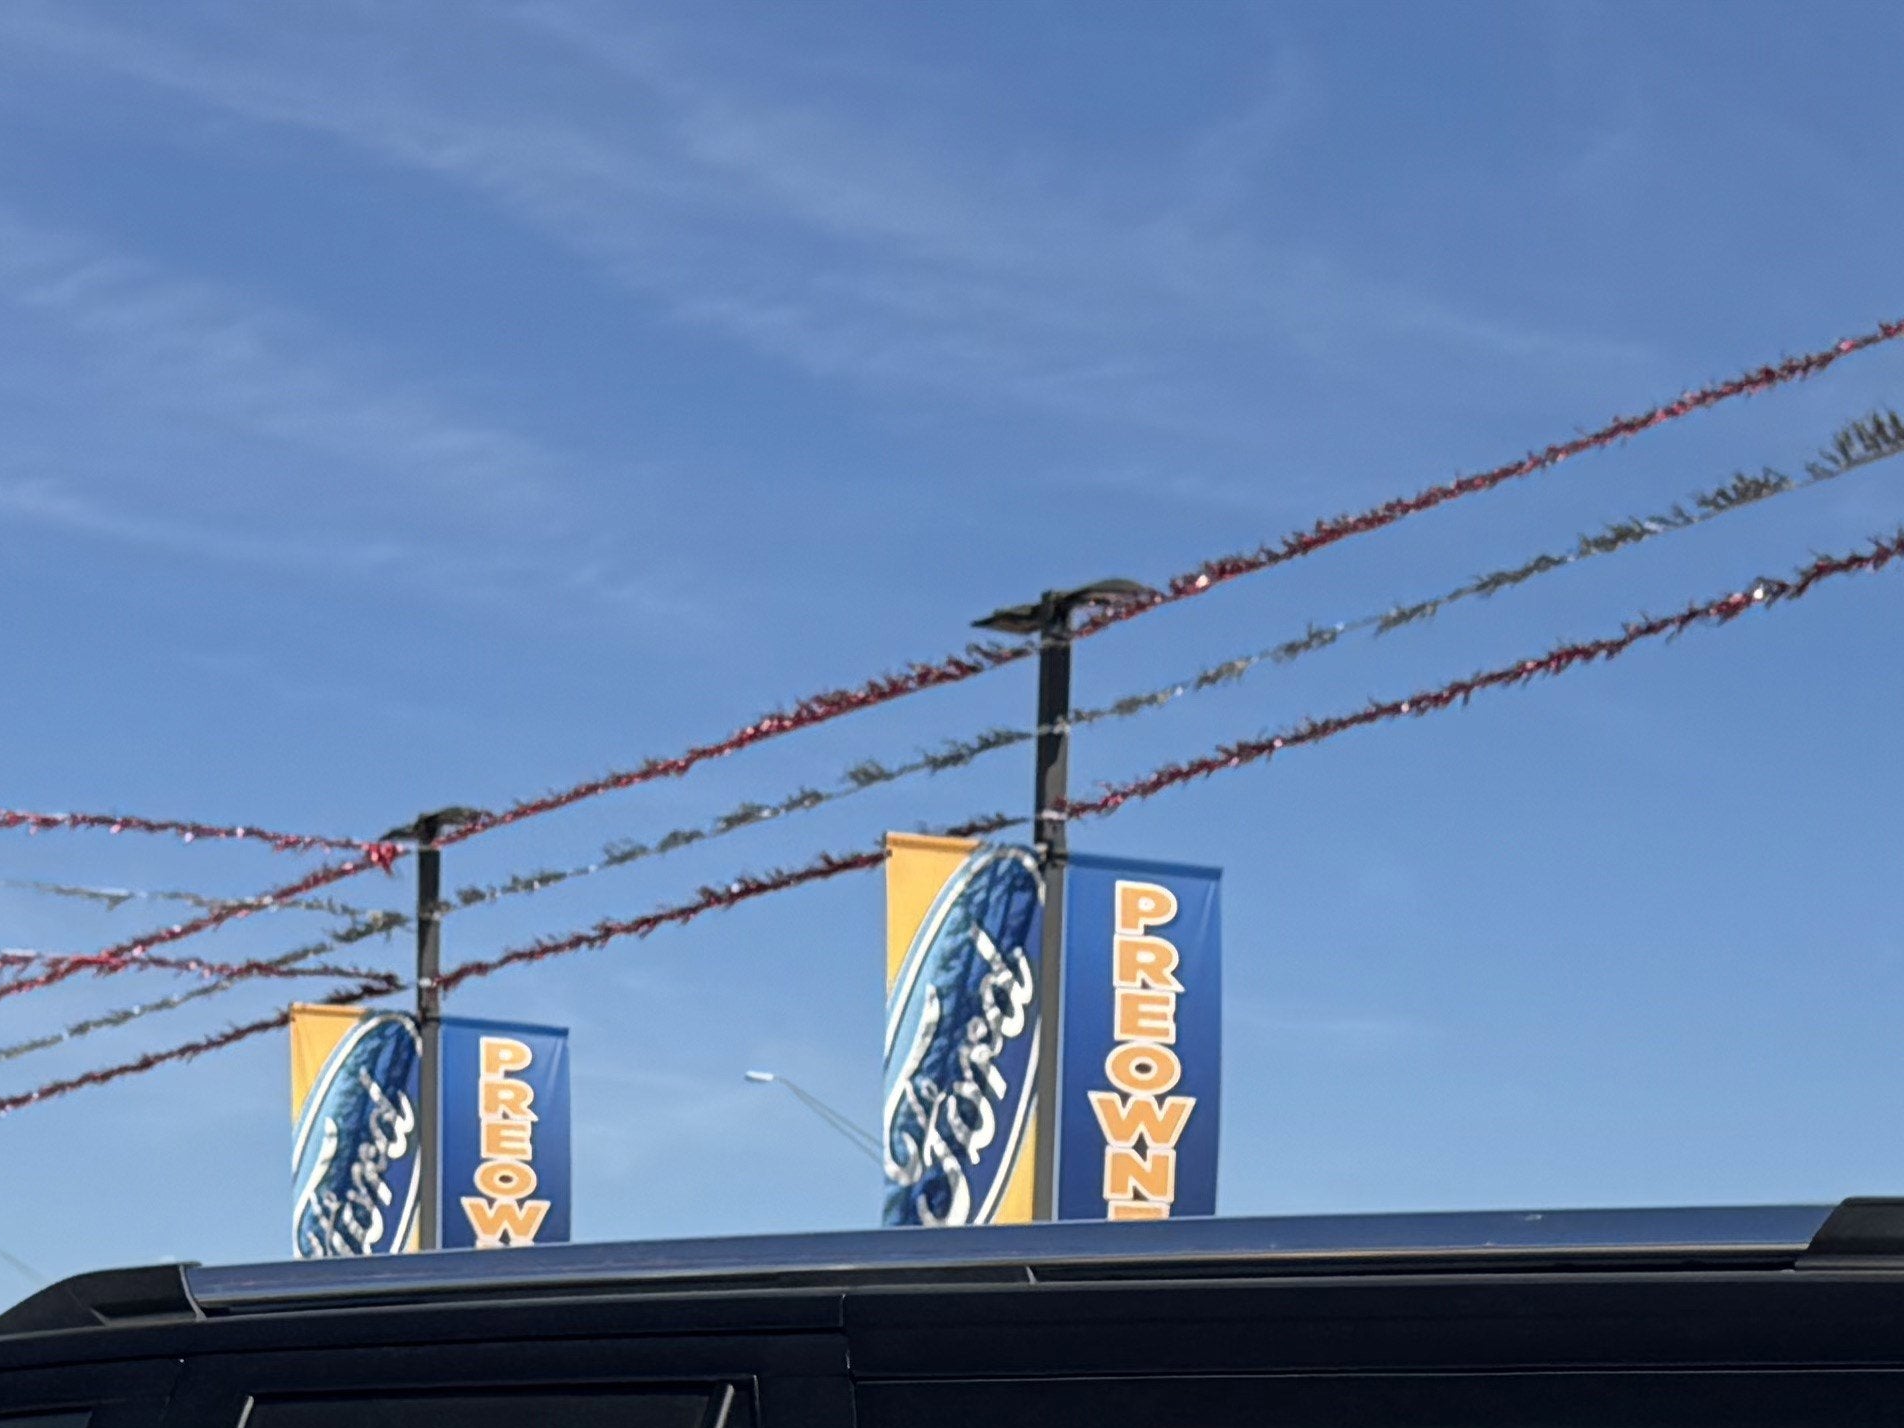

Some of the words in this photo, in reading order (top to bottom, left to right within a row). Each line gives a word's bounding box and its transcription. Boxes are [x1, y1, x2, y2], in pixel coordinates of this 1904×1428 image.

[460, 1036, 551, 1247] PREOW
[882, 923, 1034, 1228] Ford
[1088, 880, 1197, 1221] PREOWN
